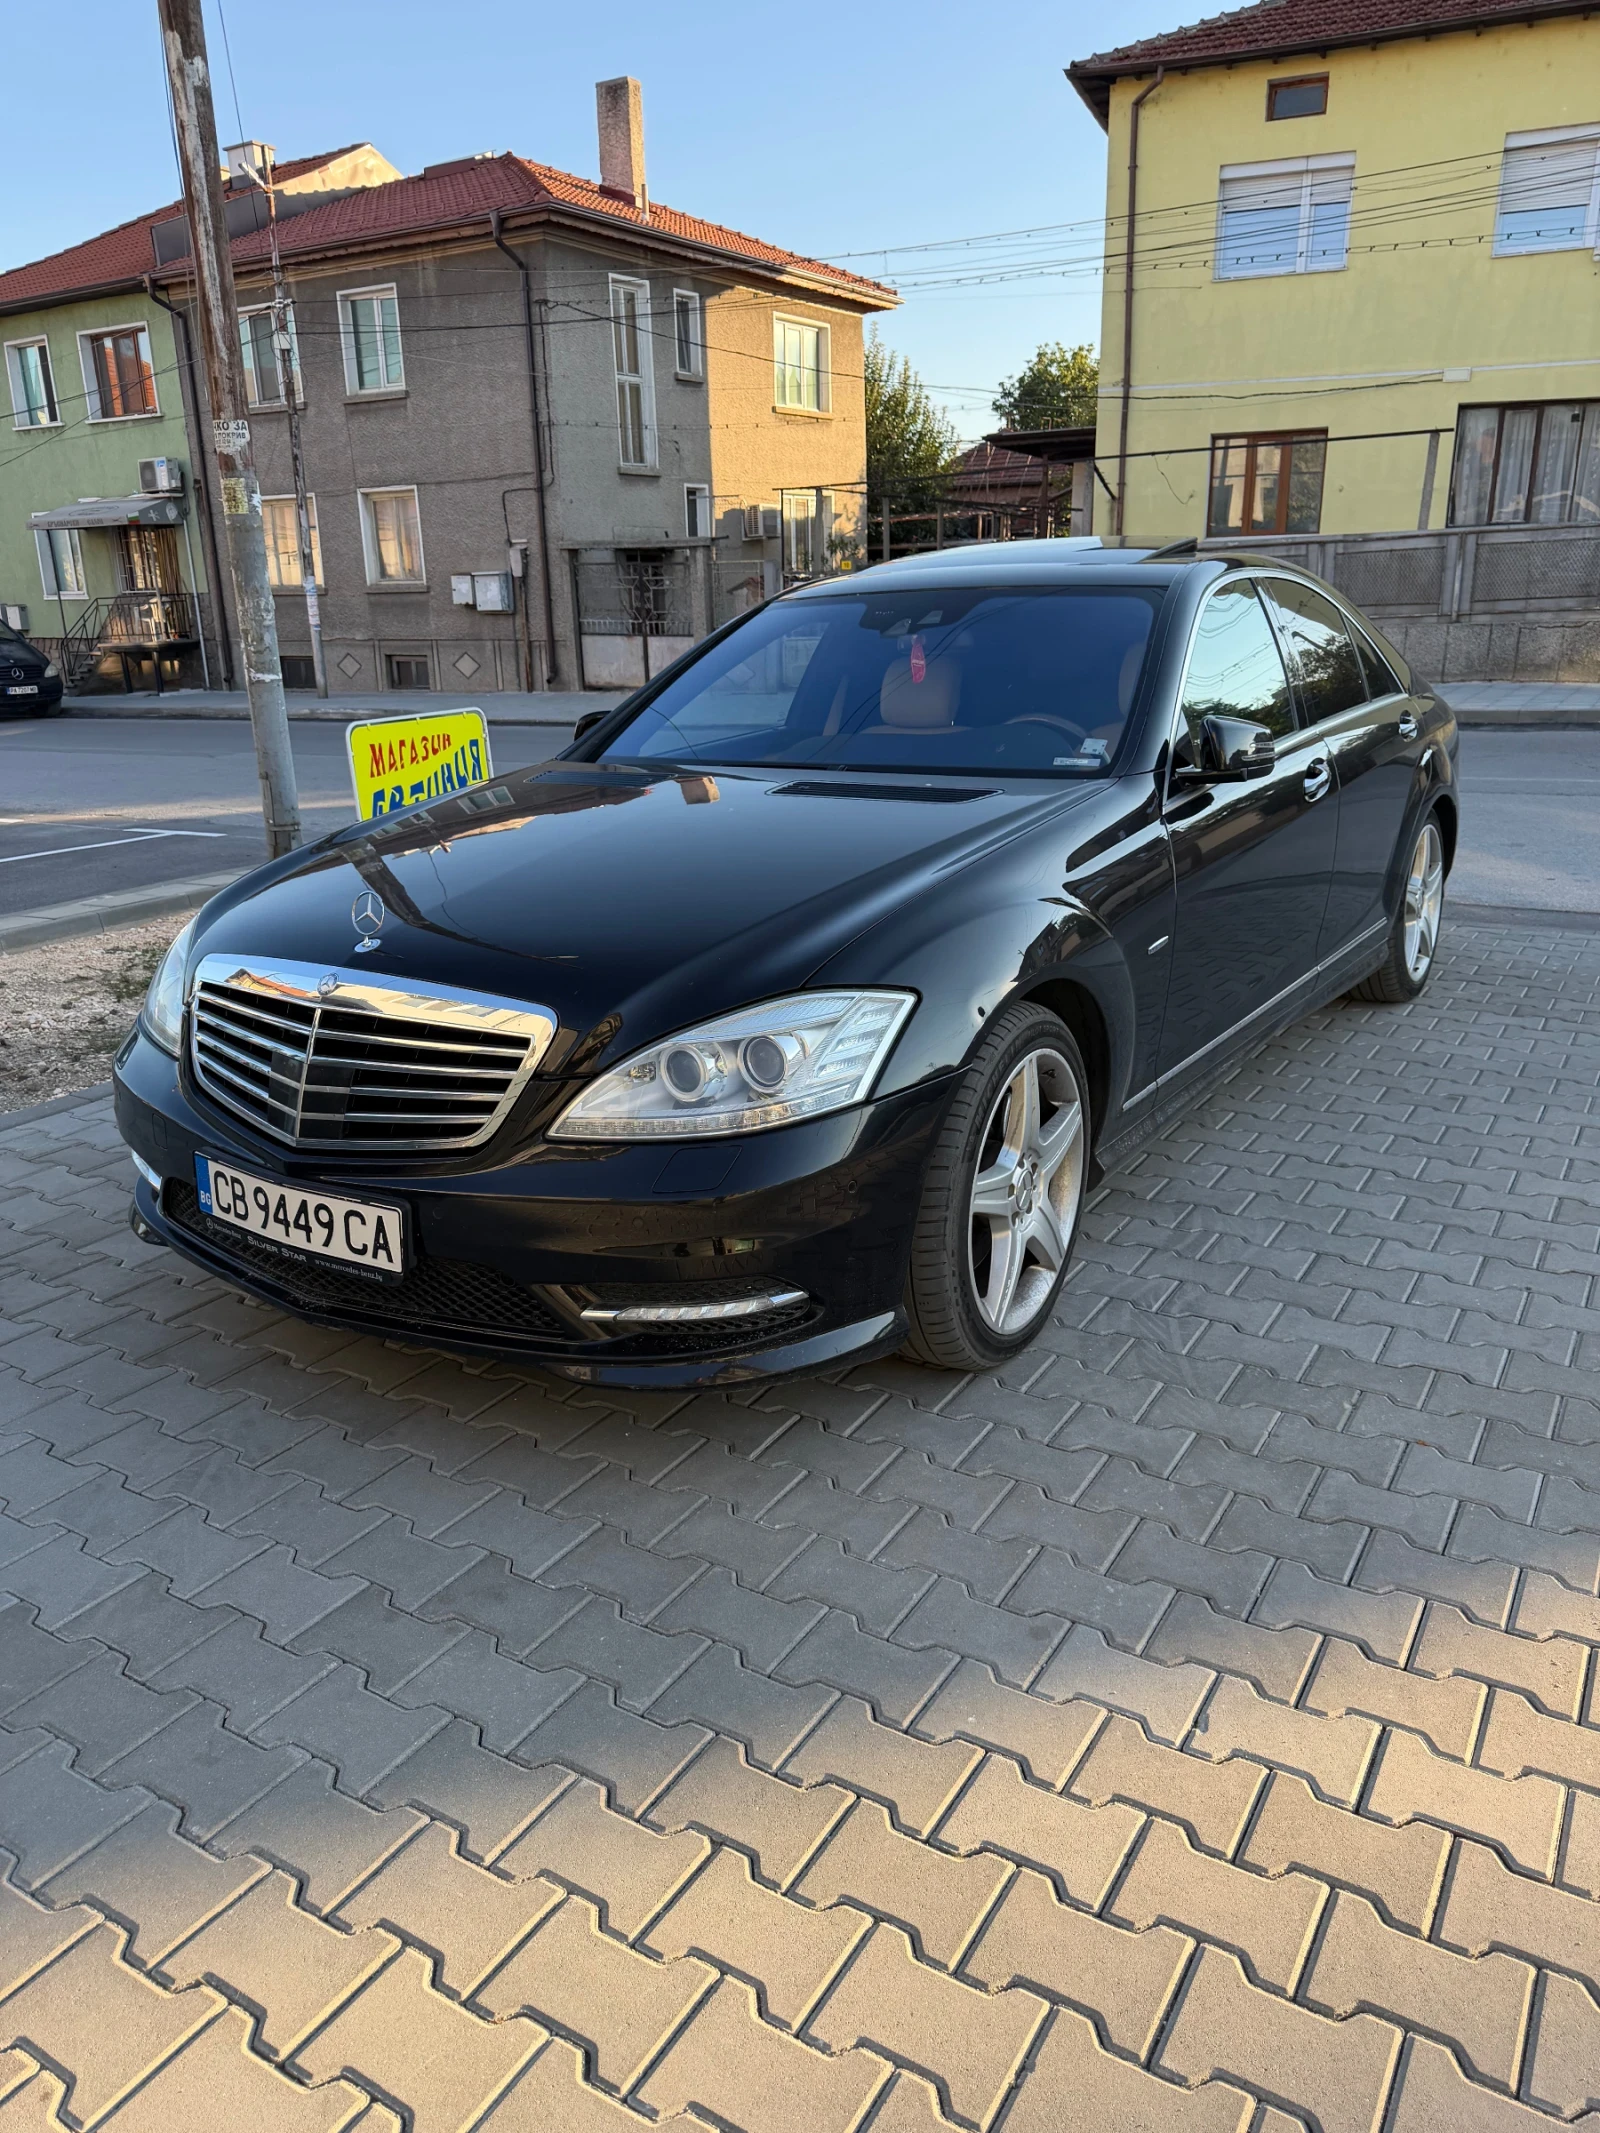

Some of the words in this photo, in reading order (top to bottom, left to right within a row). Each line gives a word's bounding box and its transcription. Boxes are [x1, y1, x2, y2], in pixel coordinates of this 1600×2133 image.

[233, 421, 248, 431] ЗА
[369, 733, 452, 778] МАГАЗИН
[200, 1190, 212, 1206] BG
[213, 1170, 249, 1221] CB
[253, 1186, 335, 1248] 9449
[343, 1209, 395, 1264] CA
